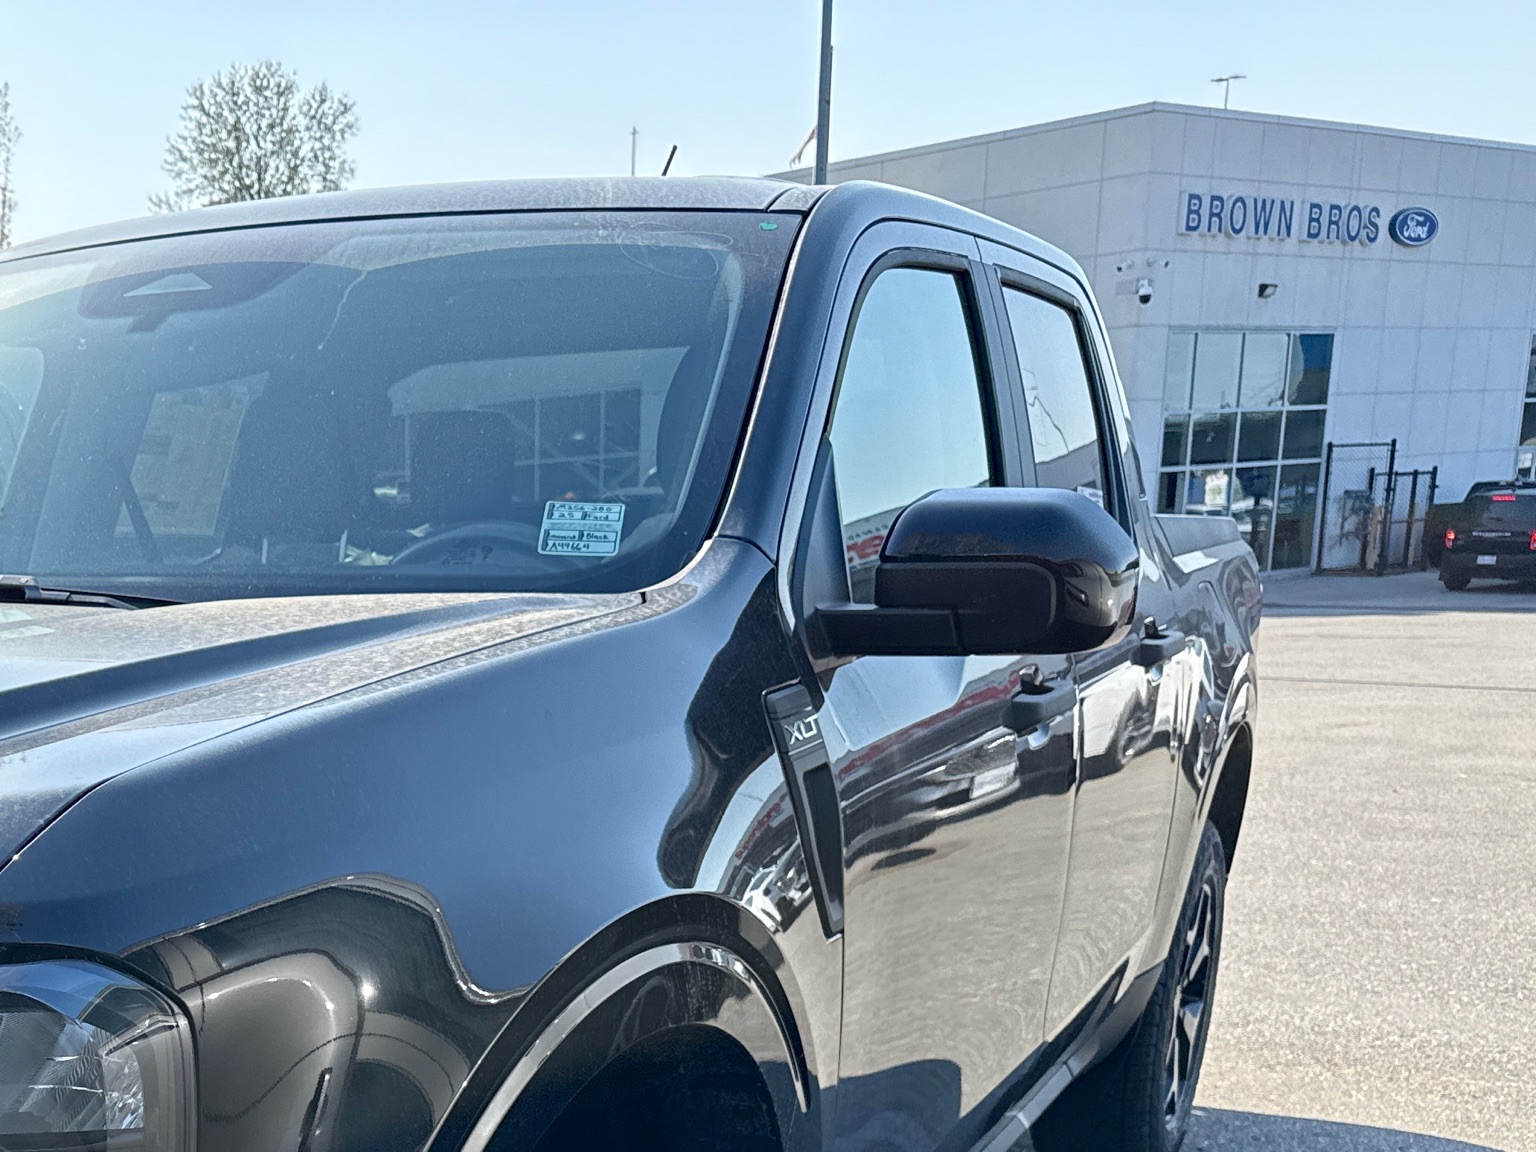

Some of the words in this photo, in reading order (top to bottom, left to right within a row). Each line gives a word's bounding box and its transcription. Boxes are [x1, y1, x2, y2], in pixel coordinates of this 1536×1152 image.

[1184, 193, 1294, 238] BROWN
[1306, 202, 1380, 243] BROS
[1404, 213, 1430, 239] Ford
[784, 714, 818, 745] XLT
